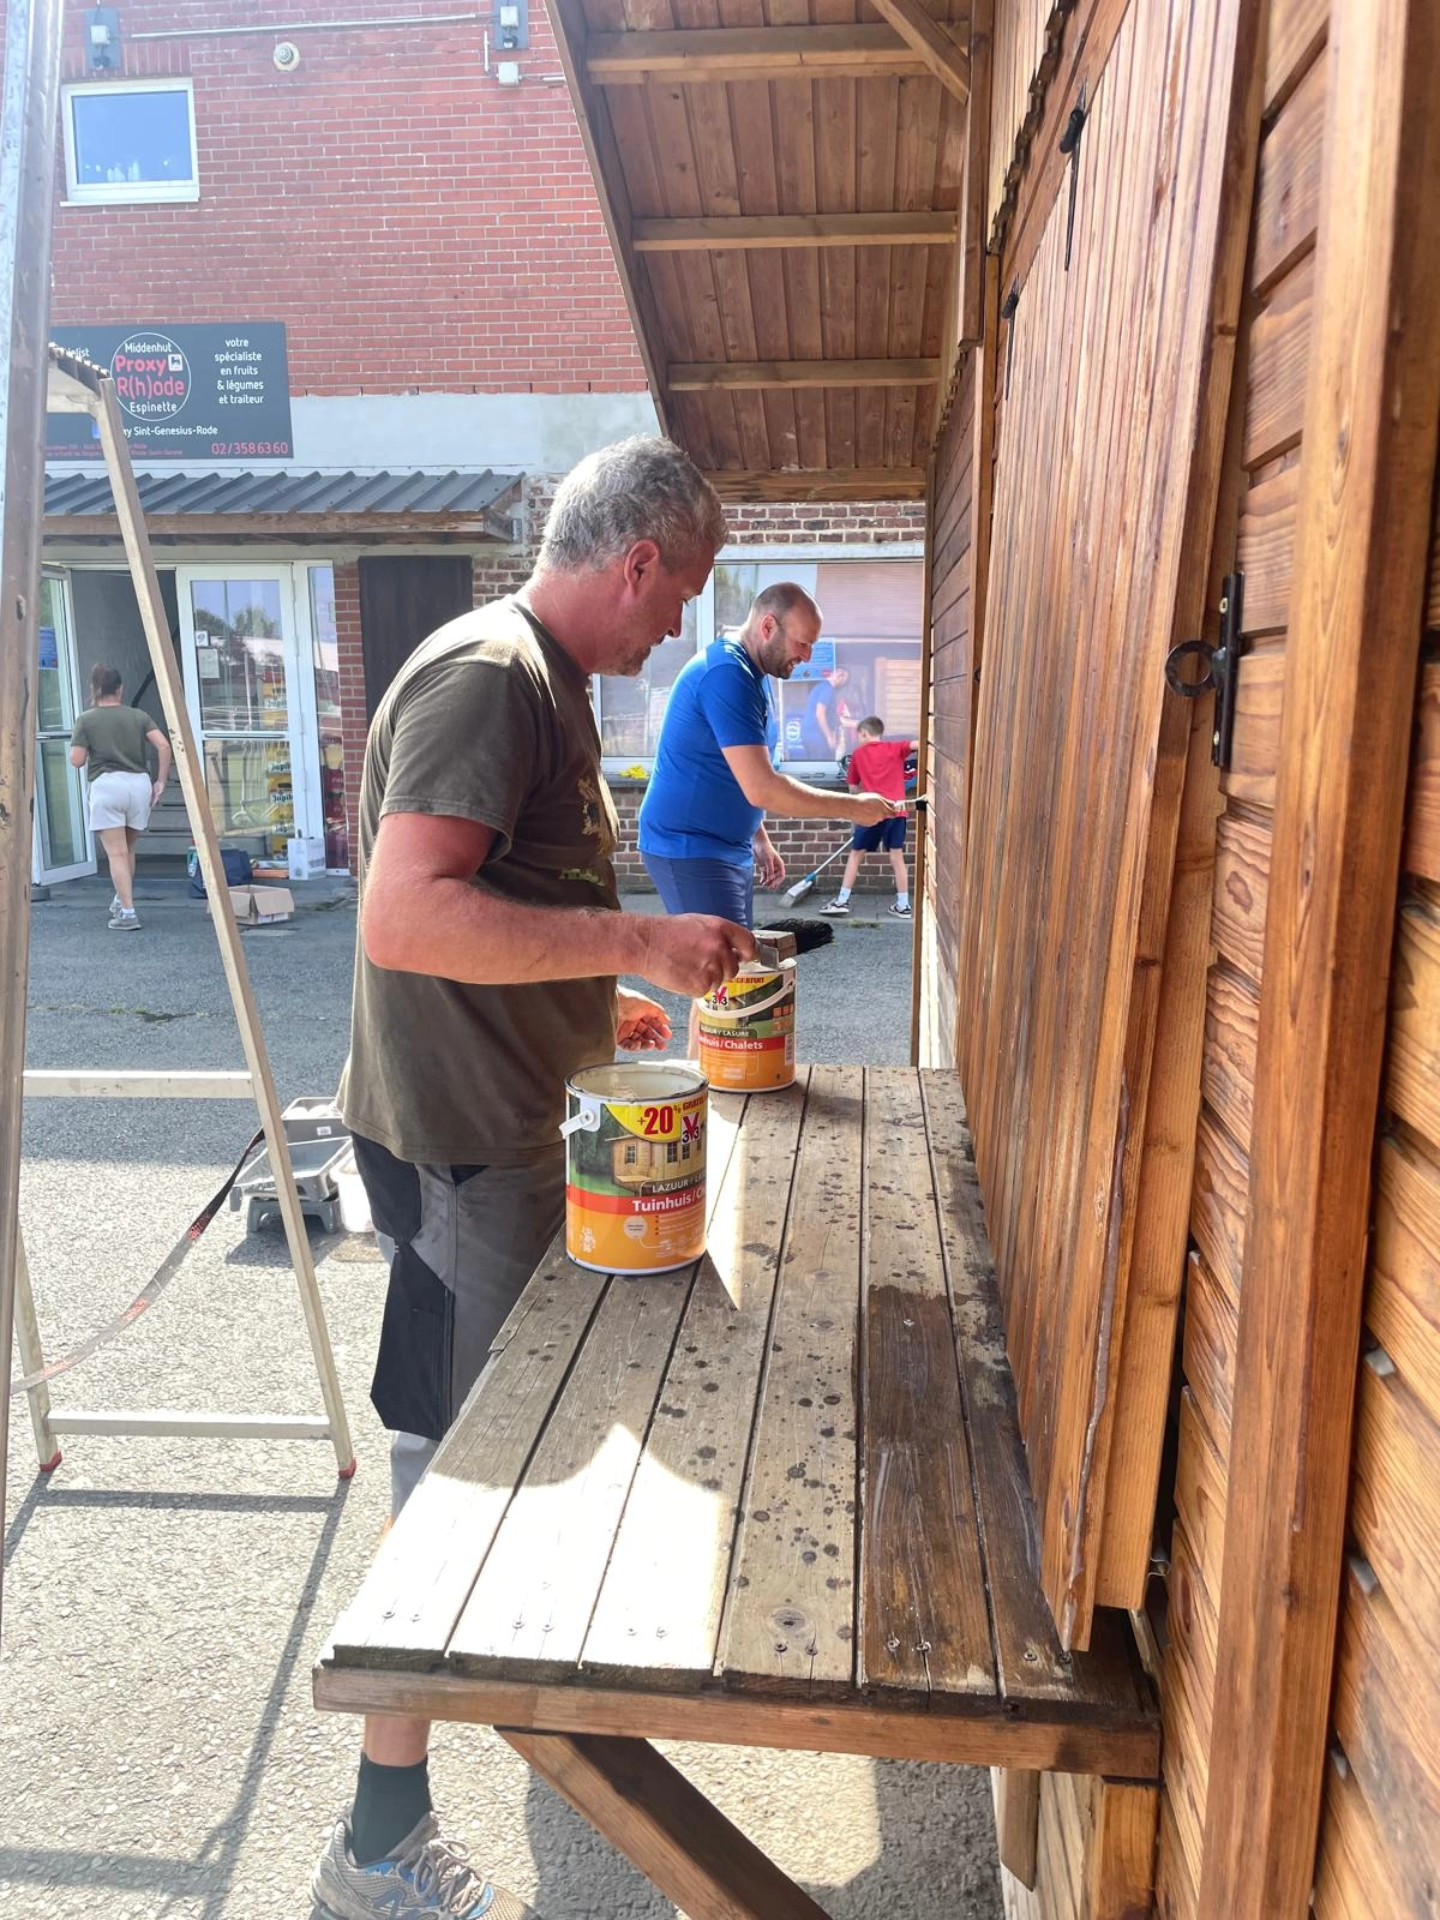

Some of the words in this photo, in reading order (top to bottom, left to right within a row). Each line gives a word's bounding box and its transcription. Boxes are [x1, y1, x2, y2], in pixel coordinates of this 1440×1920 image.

[125, 342, 172, 353] Middenhut
[225, 337, 249, 347] votre
[214, 351, 262, 364] spécialiste
[115, 354, 167, 377] Proxy
[220, 367, 232, 375] en
[233, 365, 259, 375] fruits
[117, 373, 185, 400] R(h)ode
[217, 380, 225, 390] &
[226, 380, 264, 393] légumes
[219, 394, 229, 404] et
[230, 394, 264, 404] traiteur
[130, 401, 177, 415] Espinette
[133, 425, 218, 436] Sint-Genesius-Rode
[652, 1180, 688, 1193] LAZUUR
